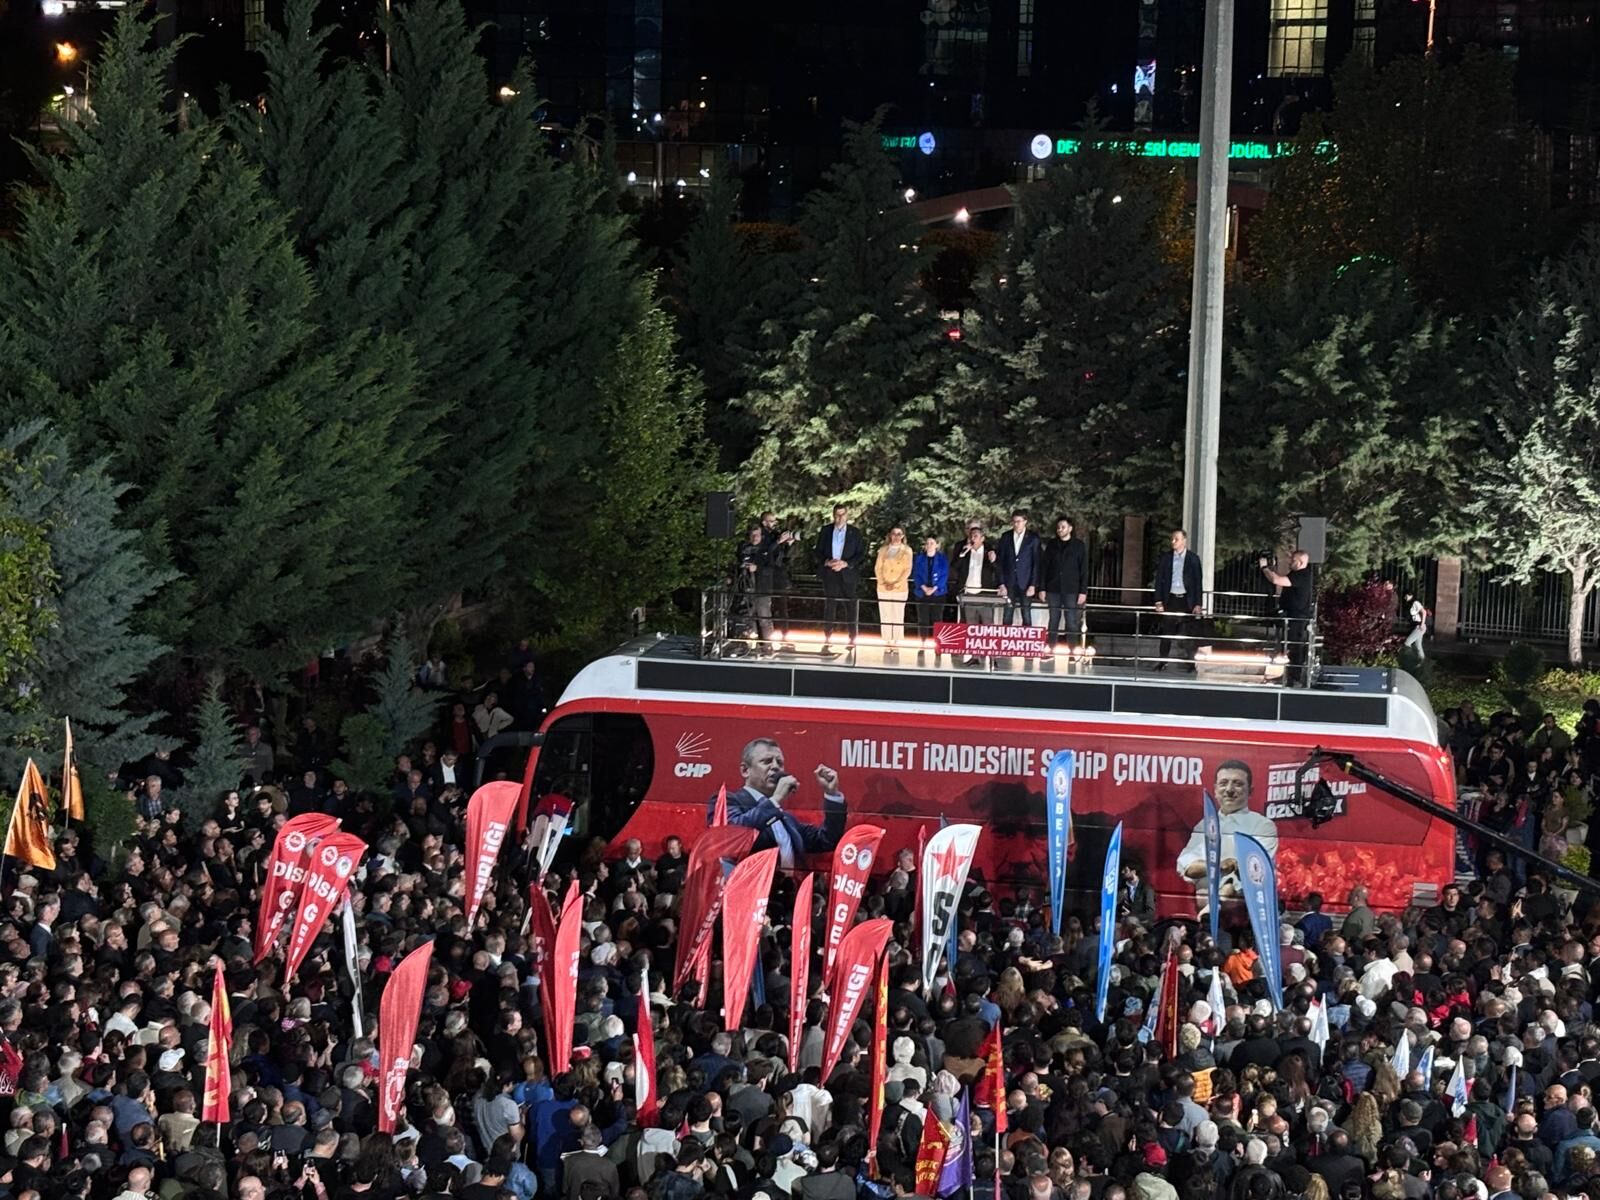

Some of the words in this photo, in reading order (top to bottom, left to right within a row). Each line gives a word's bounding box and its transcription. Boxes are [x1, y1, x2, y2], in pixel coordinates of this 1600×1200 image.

[967, 625, 1044, 639] CUMHURİYET
[965, 638, 998, 650] HALK
[1001, 640, 1046, 652] PARTİSİ
[840, 738, 918, 770] MİLLET
[923, 742, 1036, 777] İRADESİNE
[1040, 748, 1108, 780] SHİP
[1112, 752, 1204, 786] ÇIKIYOR
[674, 762, 712, 778] CHP
